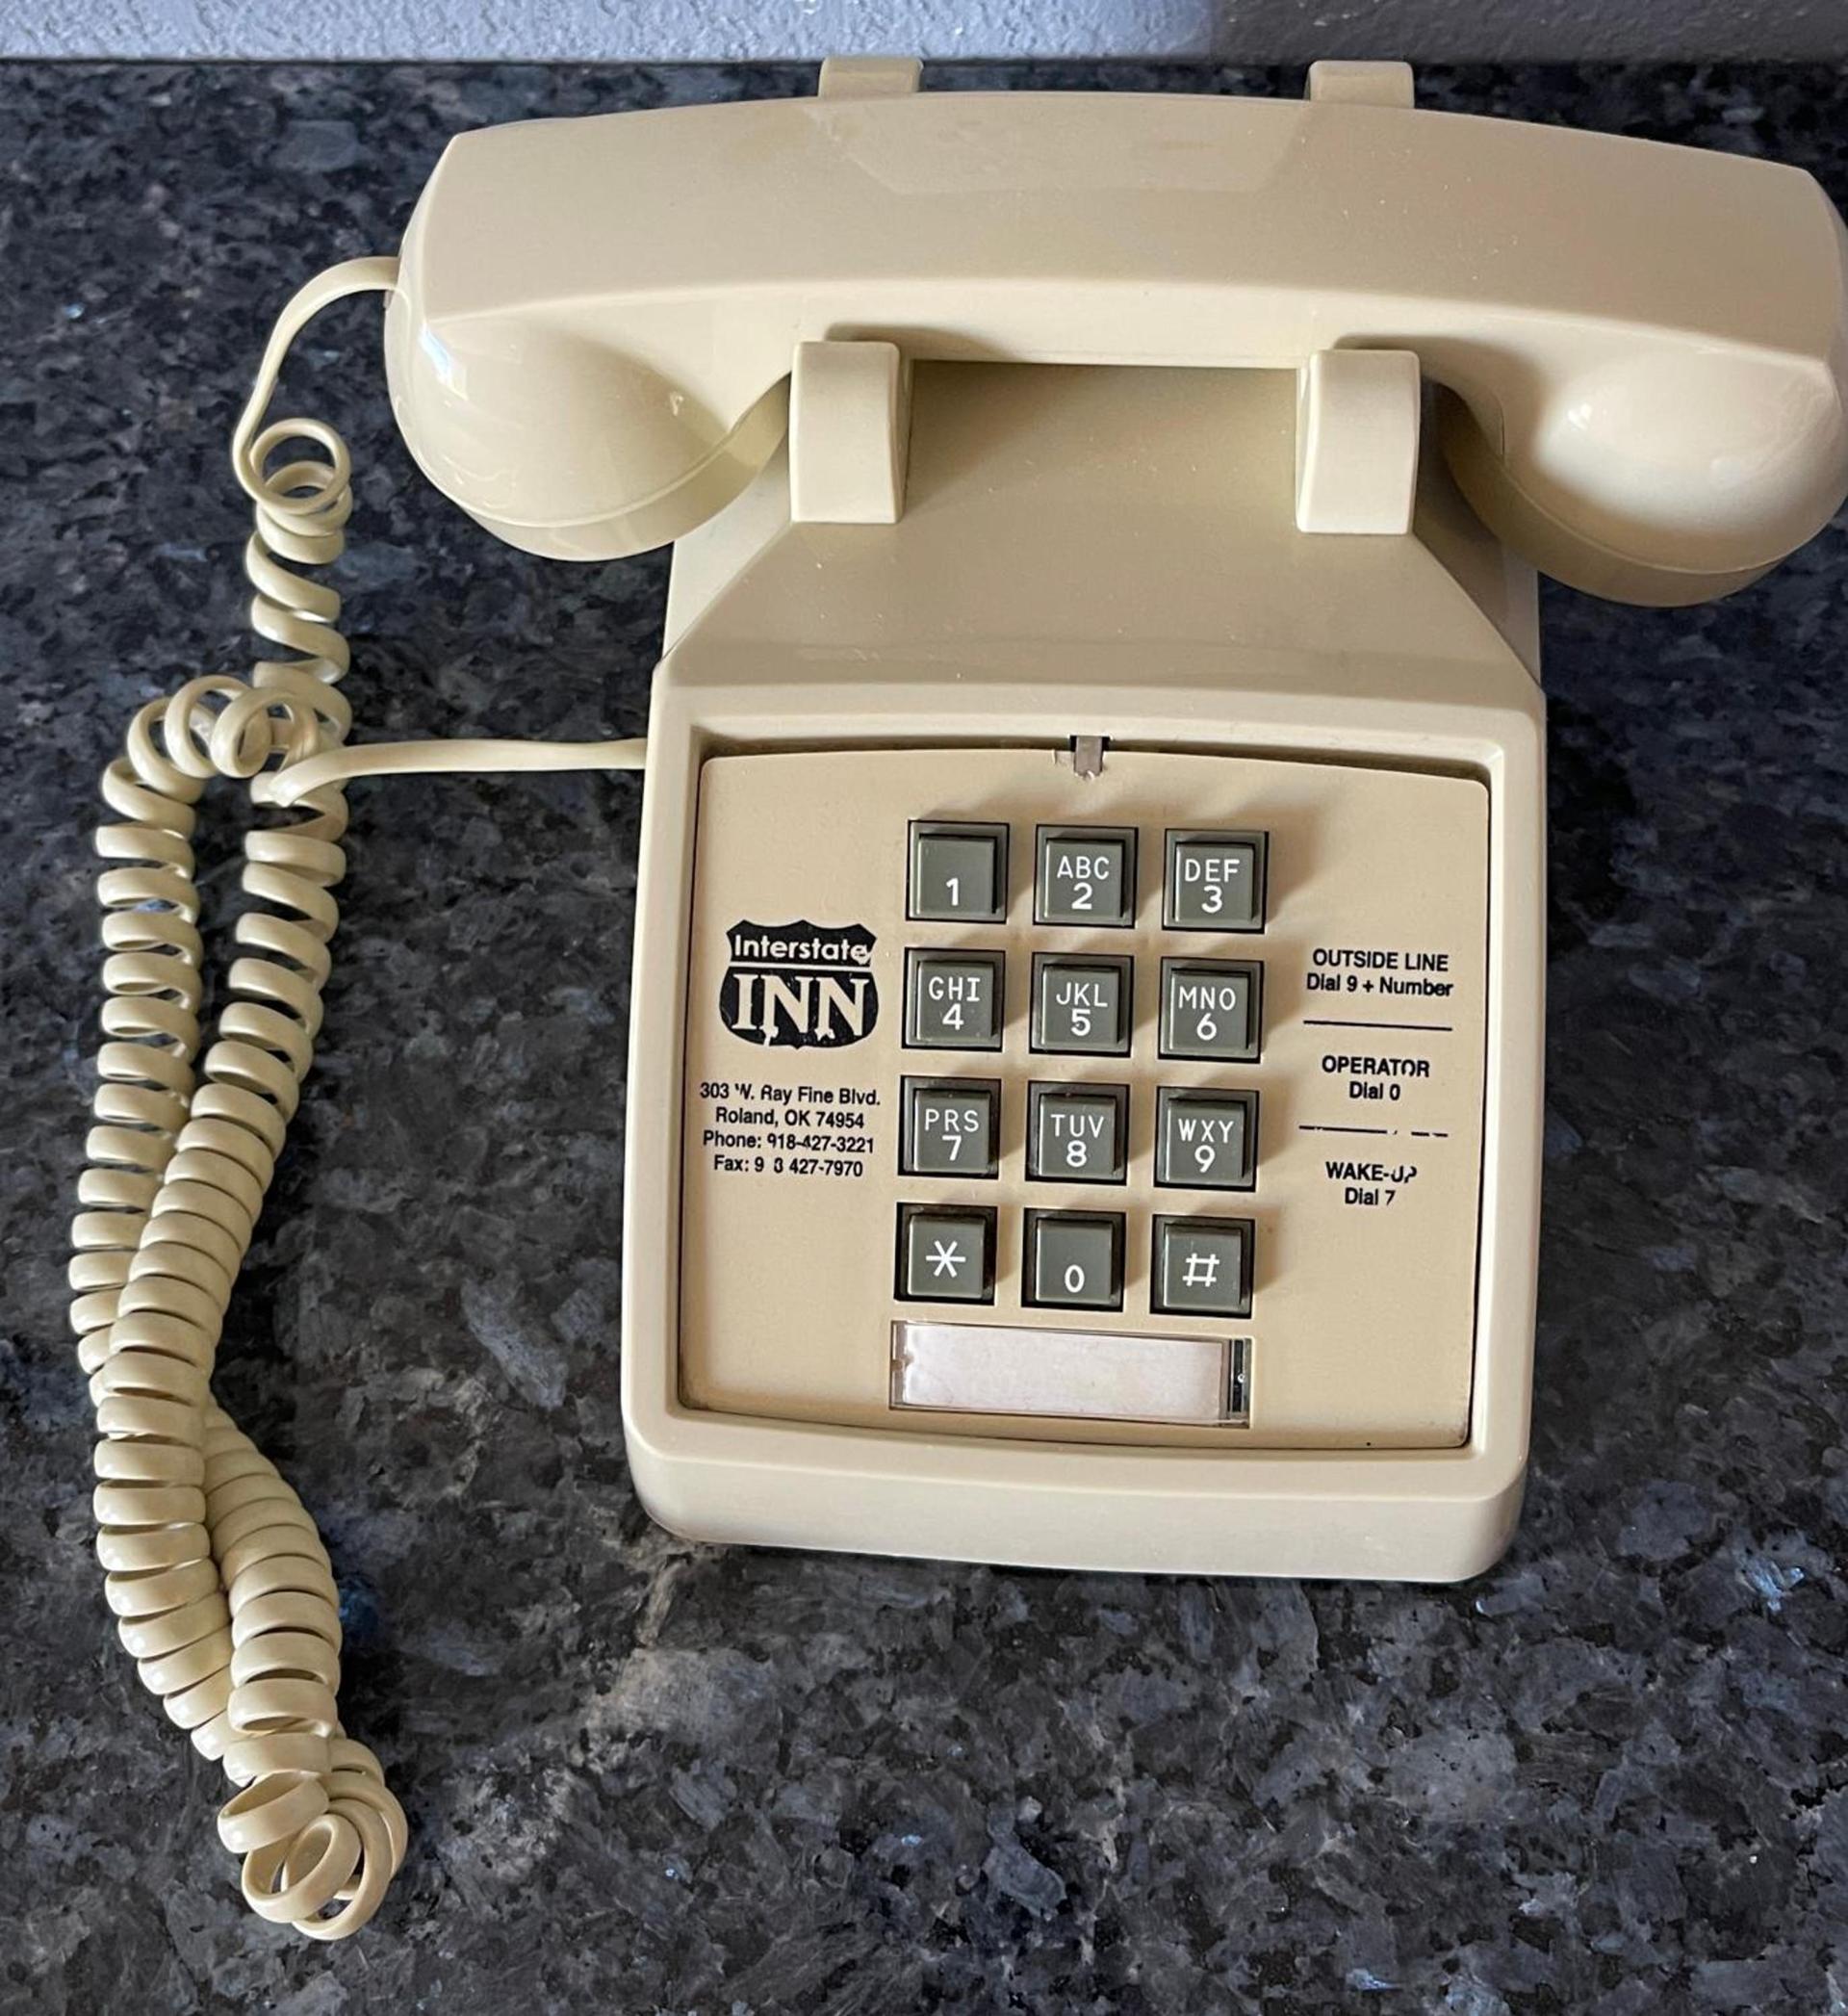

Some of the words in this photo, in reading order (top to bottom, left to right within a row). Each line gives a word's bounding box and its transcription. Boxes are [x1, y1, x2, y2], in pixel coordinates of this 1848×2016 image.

[1057, 855, 1110, 880] ABC
[1185, 859, 1240, 883] DEF
[946, 877, 959, 906] 1
[1071, 882, 1092, 910] 2
[1201, 885, 1222, 914] 3
[733, 934, 868, 961] Interstate
[1312, 947, 1399, 970] OUTSIDE
[1404, 952, 1449, 972] LINE
[928, 976, 981, 1002] GHI
[1056, 982, 1108, 1007] JKL
[1306, 972, 1341, 992] Dial
[1347, 974, 1358, 993] 9
[1362, 979, 1374, 994] +
[1379, 976, 1454, 997] Number
[732, 973, 870, 1038] INN
[1178, 986, 1236, 1011] MNO
[942, 1003, 964, 1030] 4
[1071, 1008, 1091, 1036] 5
[1196, 1013, 1217, 1041] 6
[1322, 1054, 1430, 1078] OPERATOR
[699, 1081, 730, 1099] 303
[734, 1083, 755, 1100] W.
[760, 1084, 793, 1106] Ray
[798, 1085, 834, 1104] Fine
[838, 1087, 881, 1106] Blvd.
[1348, 1080, 1384, 1099] Dial
[1389, 1083, 1401, 1101] 0
[715, 1106, 779, 1127] Roland,
[784, 1109, 810, 1127] OK
[815, 1111, 864, 1129] 74954
[925, 1108, 979, 1132] PRS
[1050, 1114, 1104, 1138] TUV
[702, 1129, 761, 1149] Phone:
[766, 1132, 874, 1153] 918-427-3221
[1178, 1118, 1234, 1144] WXY
[941, 1135, 962, 1161] 7
[1066, 1140, 1087, 1167] 8
[1194, 1145, 1216, 1173] 9
[713, 1153, 750, 1173] Fax:
[1345, 1186, 1379, 1205] Dial
[1384, 1189, 1396, 1205] 7
[1182, 1253, 1220, 1287] #
